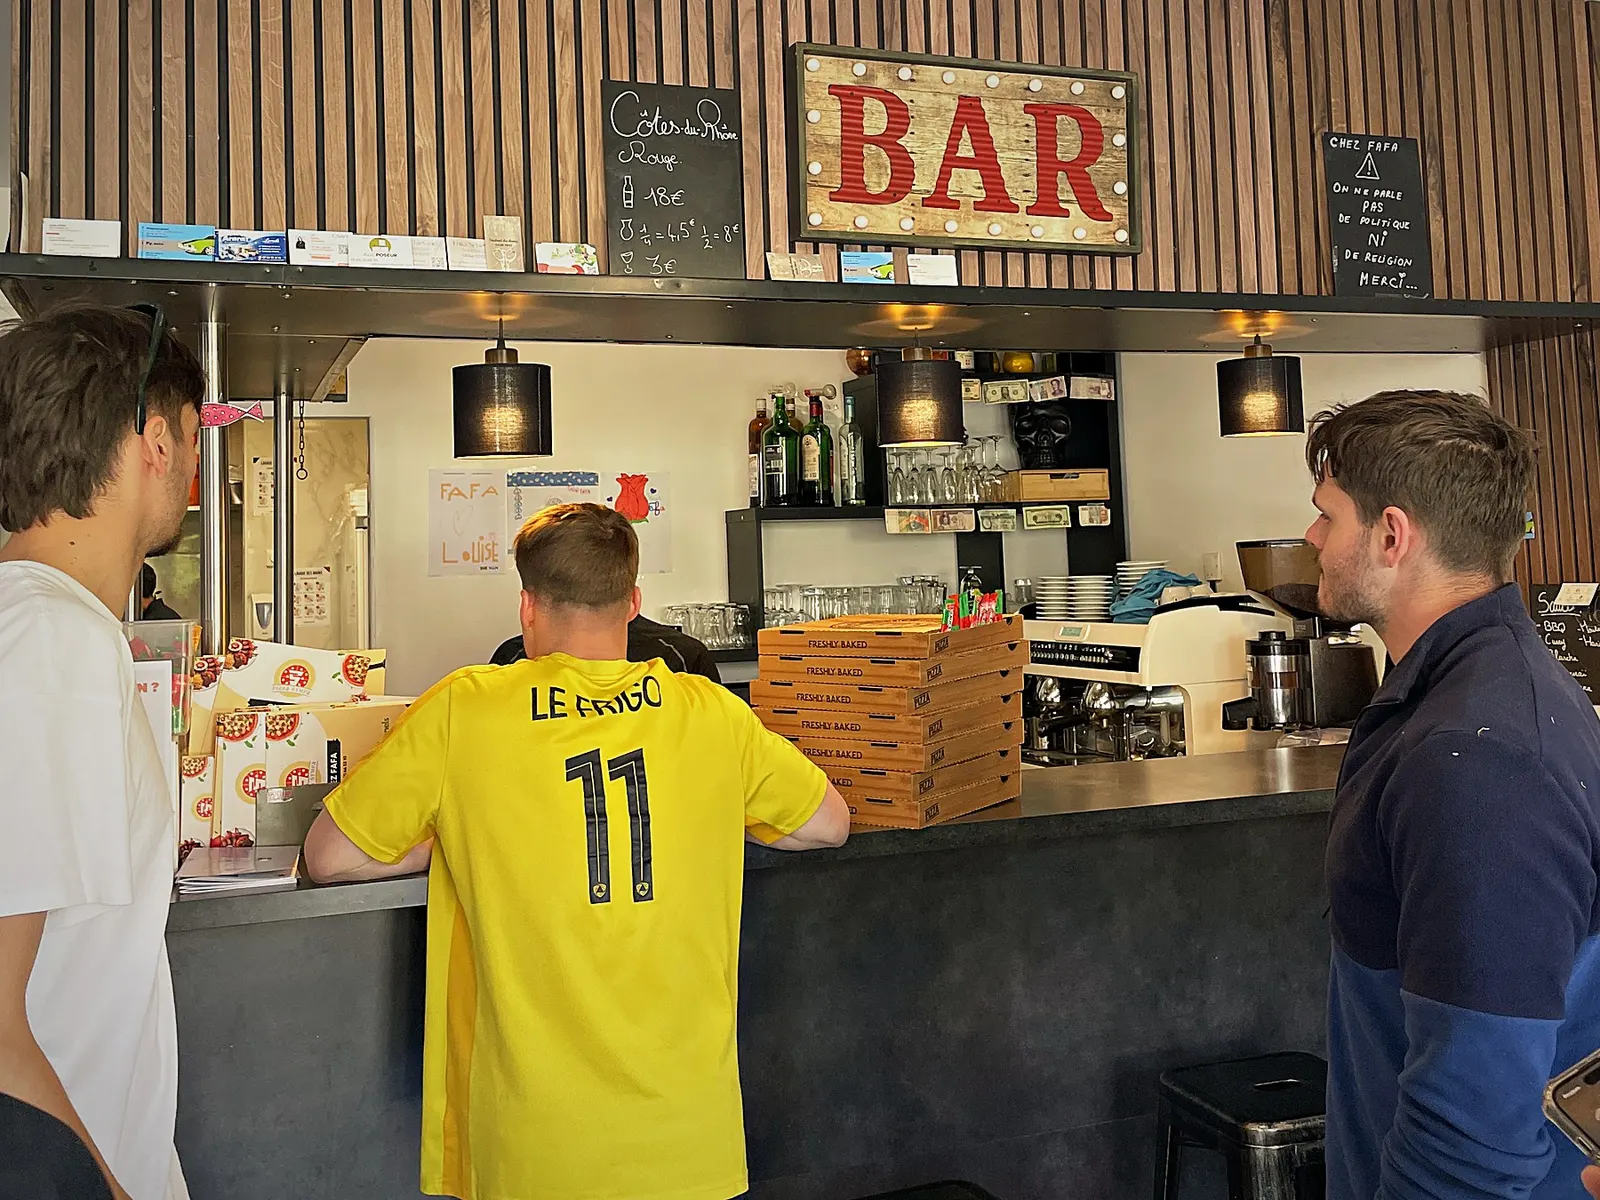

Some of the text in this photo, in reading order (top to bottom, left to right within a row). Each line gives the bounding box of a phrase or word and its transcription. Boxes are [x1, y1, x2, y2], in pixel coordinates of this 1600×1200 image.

[827, 84, 1114, 222] BAR
[1329, 136, 1399, 152] CHEZ FAFA
[643, 187, 685, 207] 18€
[1354, 187, 1370, 196] NE
[1373, 189, 1403, 201] PARLE
[1362, 200, 1384, 213] PAS
[1338, 213, 1351, 224] DE
[1344, 249, 1360, 260] DE
[645, 254, 678, 275] 3€
[440, 483, 499, 502] FAFA
[1543, 620, 1566, 633] BBQ
[808, 639, 868, 650] FRESHLY BAKED
[934, 636, 949, 654] PIZZA
[806, 667, 864, 678] FRESHLY BAKED
[926, 663, 943, 682] PIZZA
[530, 675, 662, 721] LE FRIGO
[795, 693, 851, 705] FRESHLY BAKED
[912, 691, 931, 710] PIZZA
[801, 721, 861, 733] FRESHLY BAKED
[927, 719, 943, 737] PIZZA
[329, 752, 338, 774] FAFA
[803, 748, 863, 760] FRESHLY BAKED
[929, 746, 944, 766] PIZZA
[829, 777, 853, 788] AKED
[918, 777, 935, 795] PIZZA
[923, 802, 940, 821] PIZZA
[564, 747, 654, 905] 11
